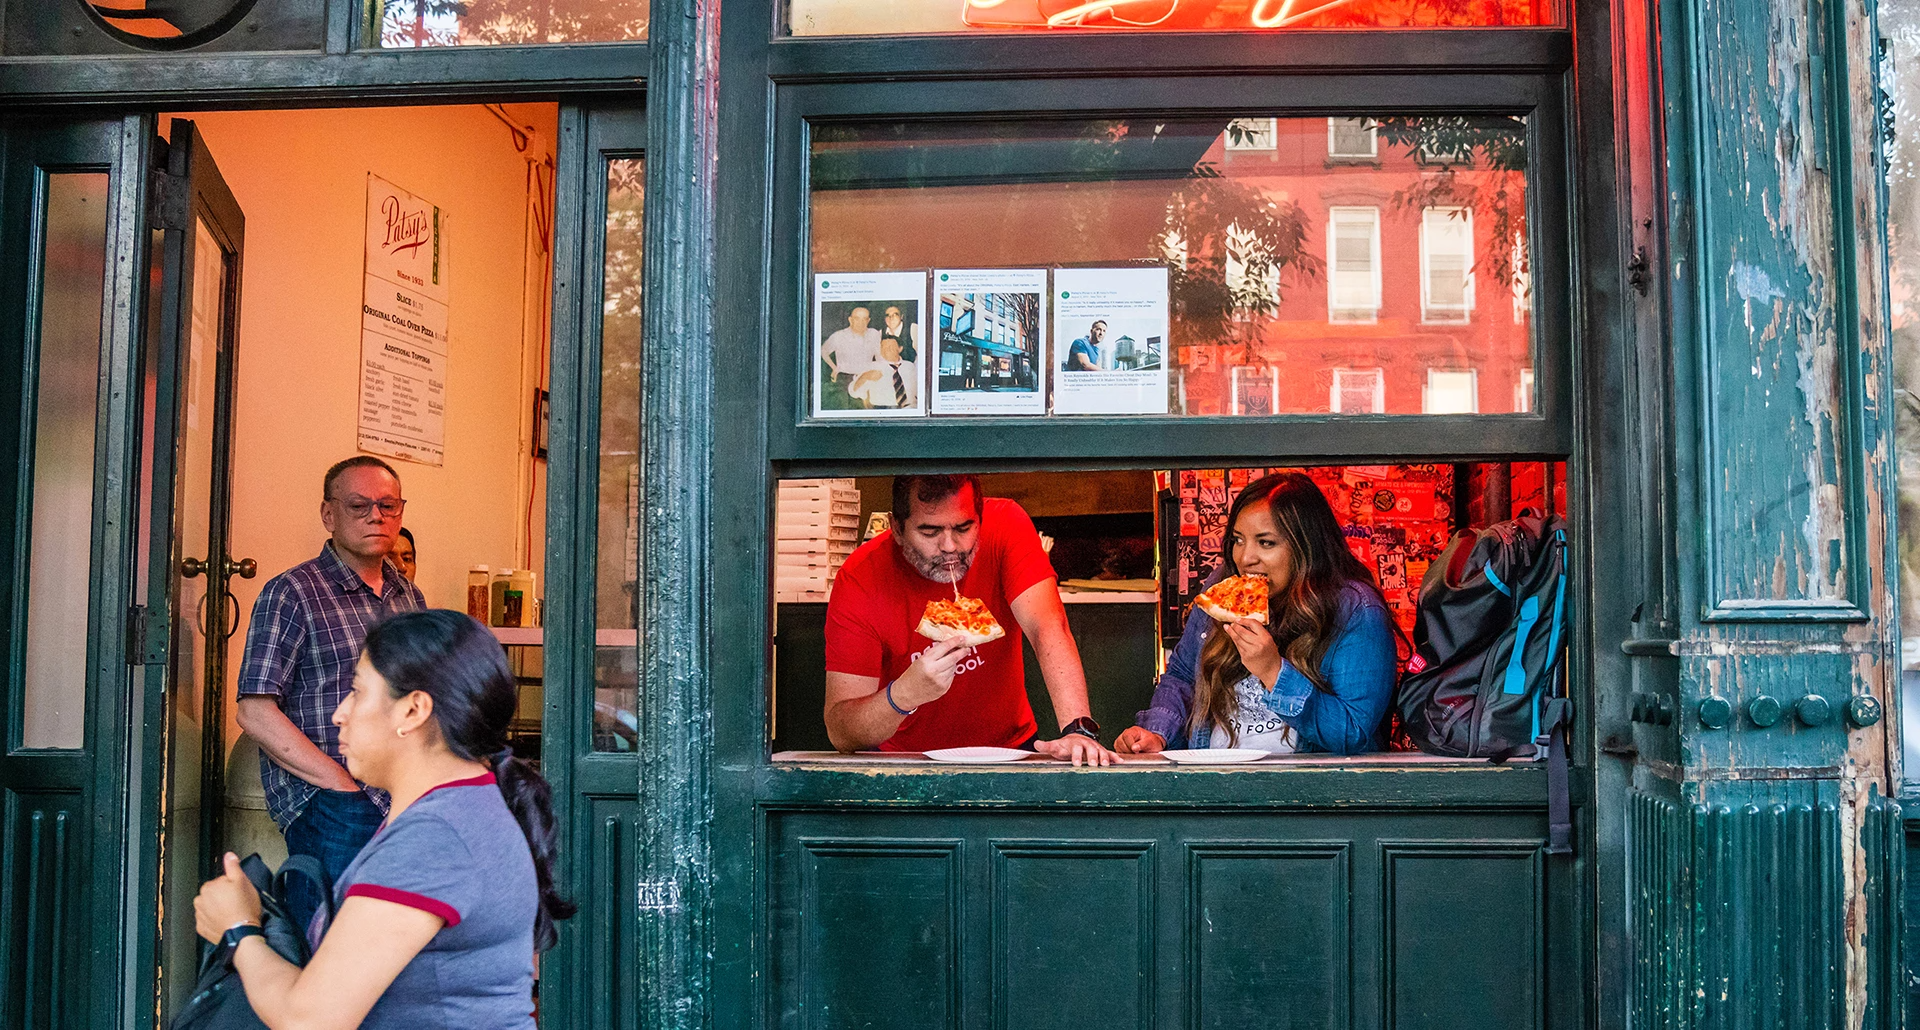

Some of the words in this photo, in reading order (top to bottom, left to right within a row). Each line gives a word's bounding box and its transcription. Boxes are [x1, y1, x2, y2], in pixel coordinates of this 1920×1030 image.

[381, 195, 430, 260] Patsy's
[397, 270, 411, 281] Since
[364, 305, 391, 322] ORIGINAL
[392, 315, 406, 327] COAL
[407, 320, 420, 332] OVEN
[422, 326, 434, 338] PIZZA
[384, 343, 411, 357] ADDITIONAL
[412, 352, 430, 364] TOPPINGS
[954, 656, 985, 675] OOL
